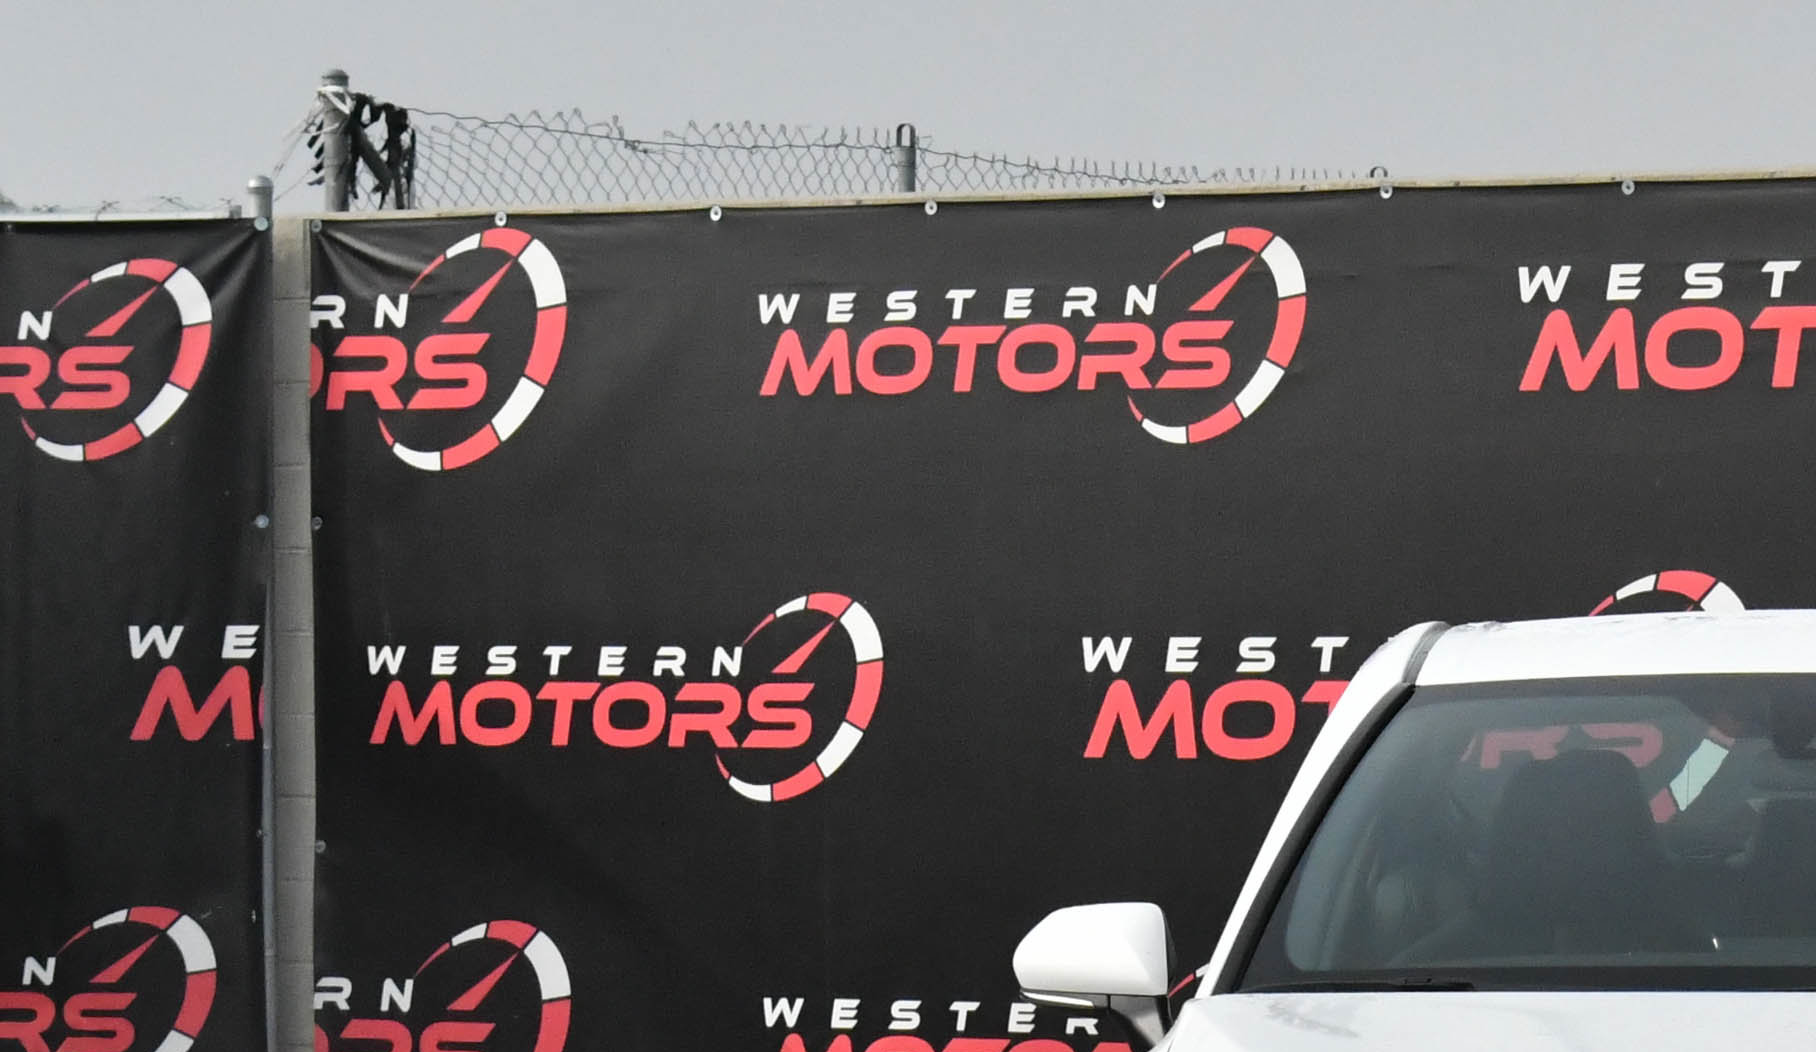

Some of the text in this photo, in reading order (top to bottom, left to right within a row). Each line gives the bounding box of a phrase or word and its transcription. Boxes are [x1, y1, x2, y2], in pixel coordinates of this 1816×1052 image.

[758, 283, 1158, 325] WESTERN
[310, 332, 492, 412] RS
[759, 319, 1235, 397] MOTORS
[367, 645, 743, 677] WESTERN
[129, 665, 265, 742] M
[369, 679, 815, 751] MOTORS
